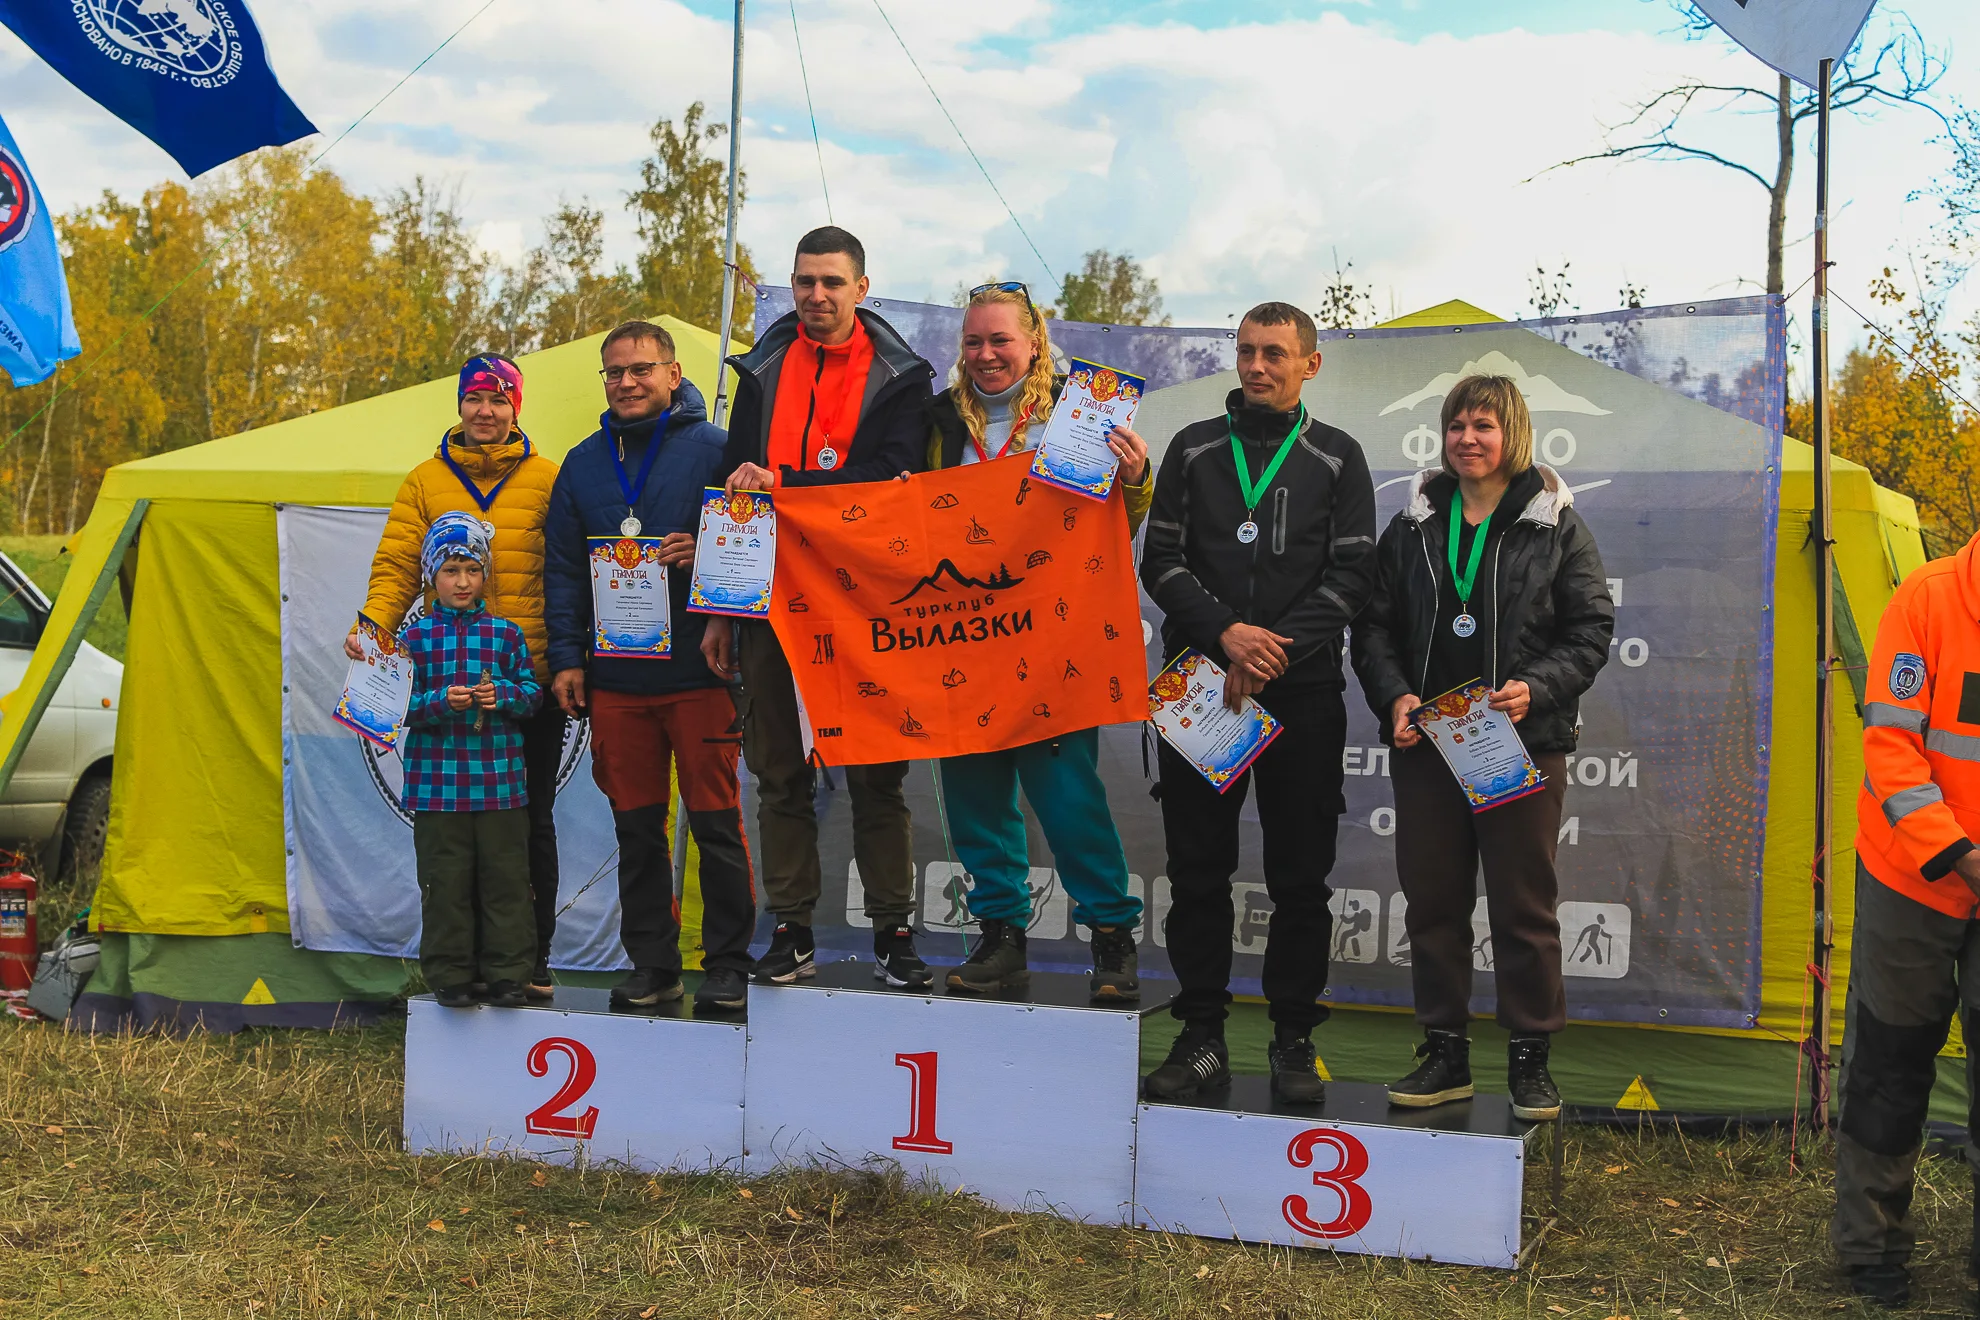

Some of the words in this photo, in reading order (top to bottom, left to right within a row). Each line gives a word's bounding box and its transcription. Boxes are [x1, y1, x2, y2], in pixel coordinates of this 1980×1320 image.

[208, 0, 239, 38] СКОЕ
[121, 53, 133, 65] В
[135, 57, 168, 75] 1845
[190, 41, 242, 89] ОБЩЕСТВО
[1079, 397, 1115, 416] ГРАМОТА
[721, 522, 758, 535] ГРАМОТА
[611, 569, 648, 579] ГРАМОТА
[904, 593, 995, 619] турклуб
[1170, 681, 1206, 717] ГРАМОТА
[1446, 709, 1486, 732] ГРАМОТА
[525, 1037, 598, 1139] 2
[892, 1051, 953, 1155] 1
[1282, 1128, 1371, 1239] 3
